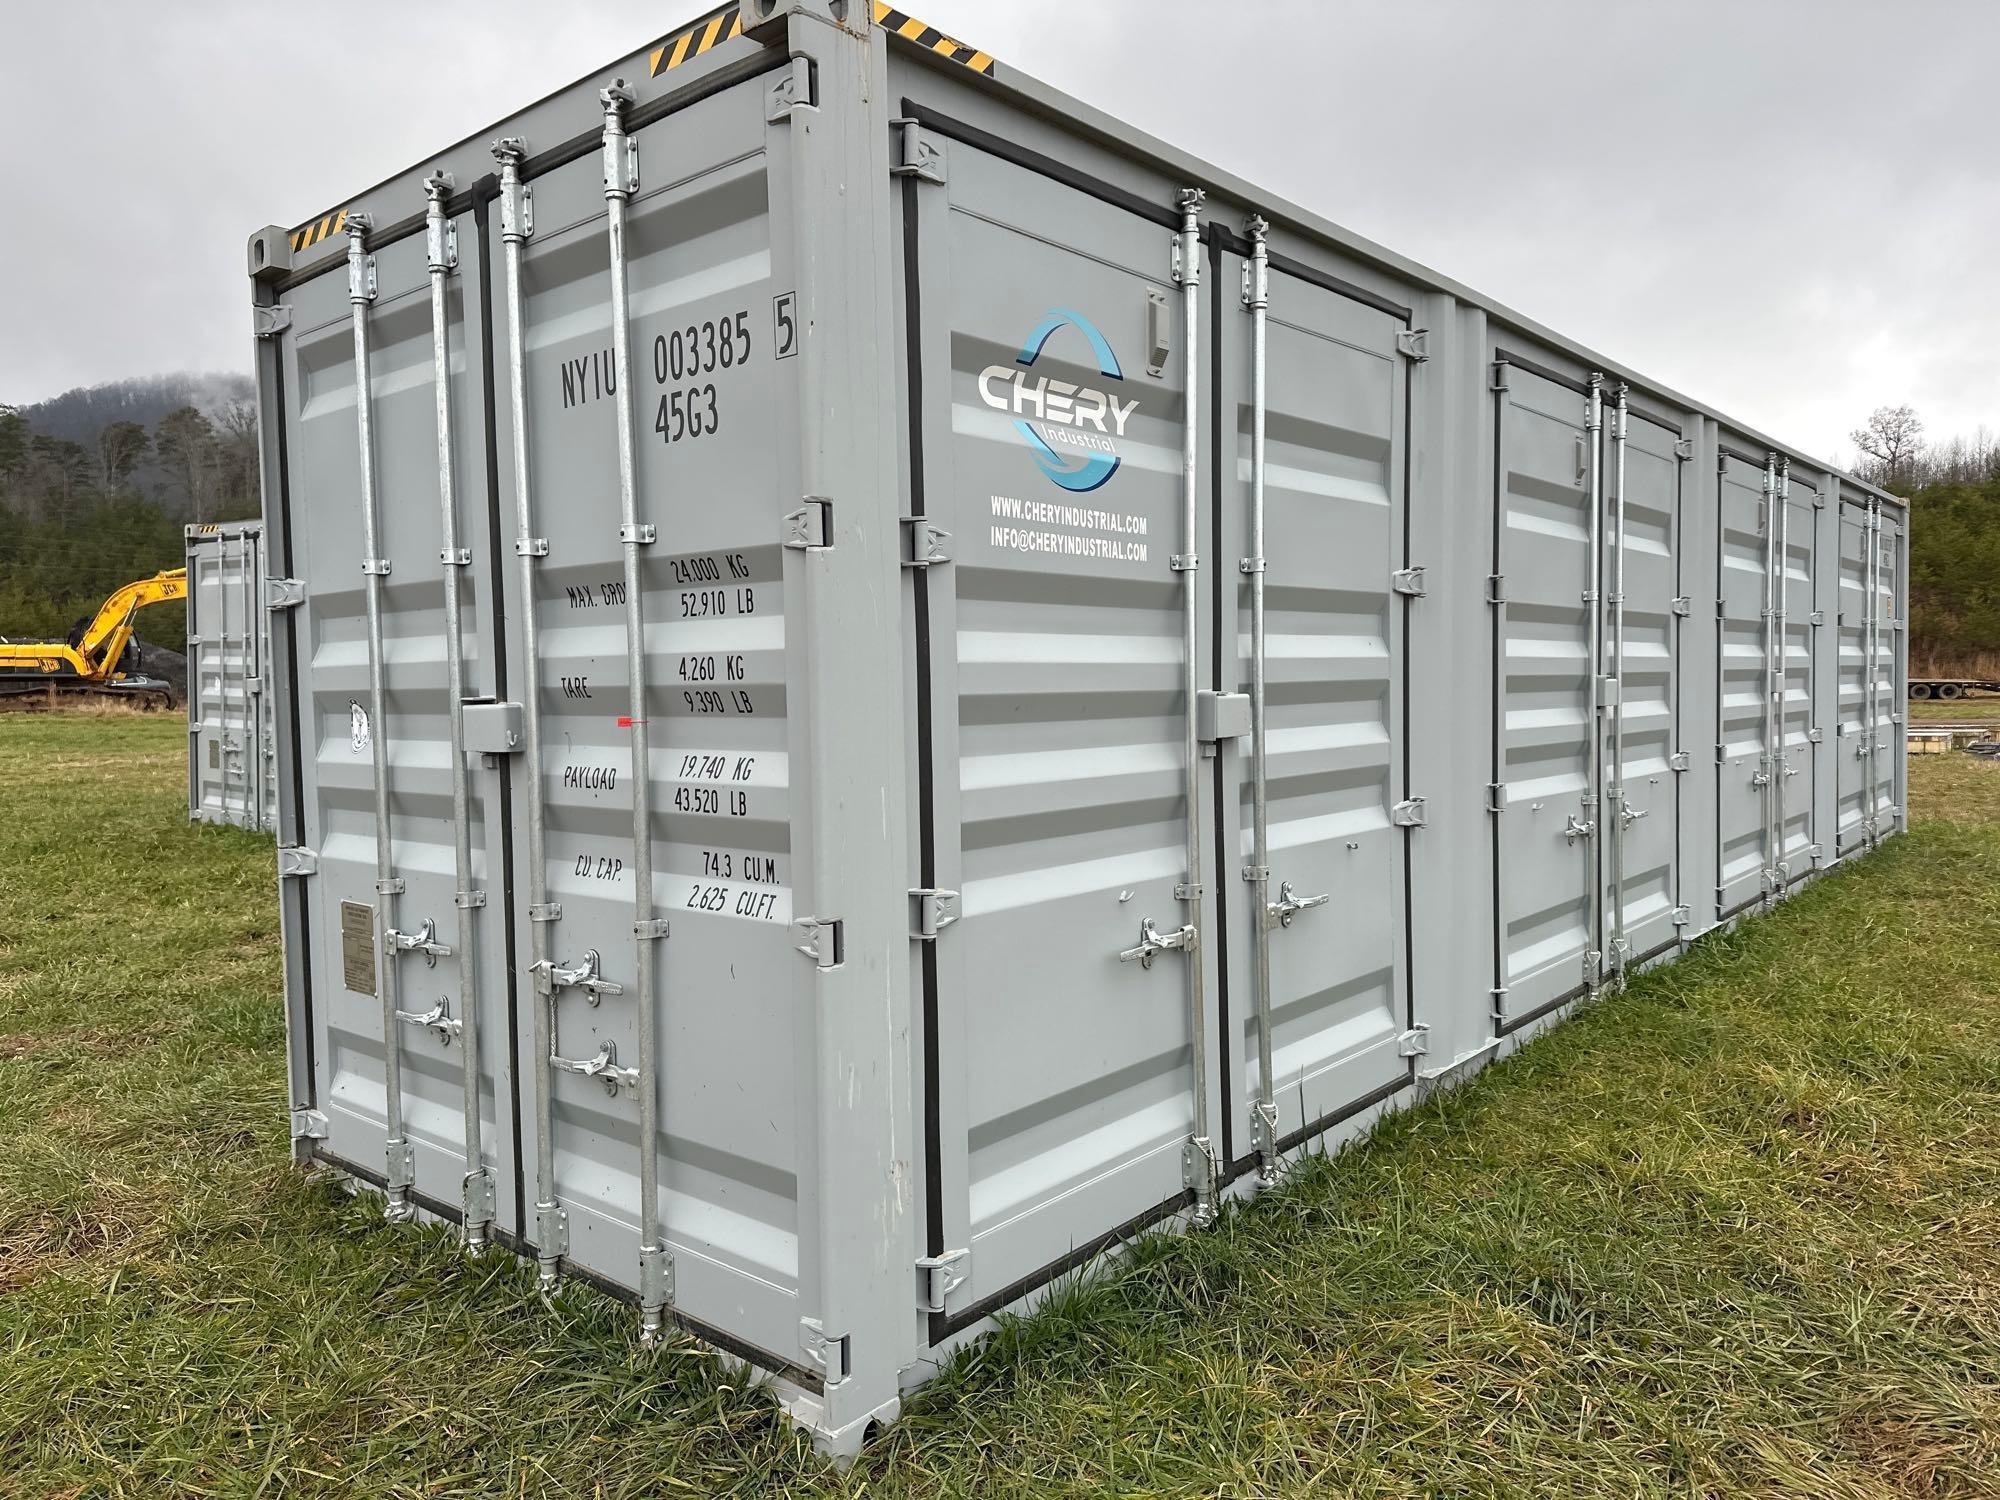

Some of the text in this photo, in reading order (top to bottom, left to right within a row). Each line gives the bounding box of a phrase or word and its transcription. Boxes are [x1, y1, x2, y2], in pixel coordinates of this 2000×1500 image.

[561, 297, 794, 409] NYIU 003385 5
[655, 384, 719, 443] 45G3
[978, 365, 1140, 436] CHERY
[1041, 423, 1117, 453] Industrial
[990, 495, 1148, 535] WWW.CHERYINDUSTRIAL.COM
[990, 525, 1149, 562] INFO@CHERYINDUSTRIAL.COM
[162, 583, 178, 595] JCB
[566, 586, 598, 608] MAX.
[600, 582, 626, 606] GRO
[725, 554, 750, 578] KG
[737, 588, 755, 614] LB
[561, 677, 592, 698] TARE
[726, 655, 744, 681] KG
[731, 691, 753, 714] LB
[564, 766, 617, 790] PAYLOAD
[732, 757, 755, 781] KG
[730, 790, 747, 816] LB
[575, 851, 780, 885] CU. CAP. 74.3 CU.M.
[735, 891, 777, 920] CU.FT.
